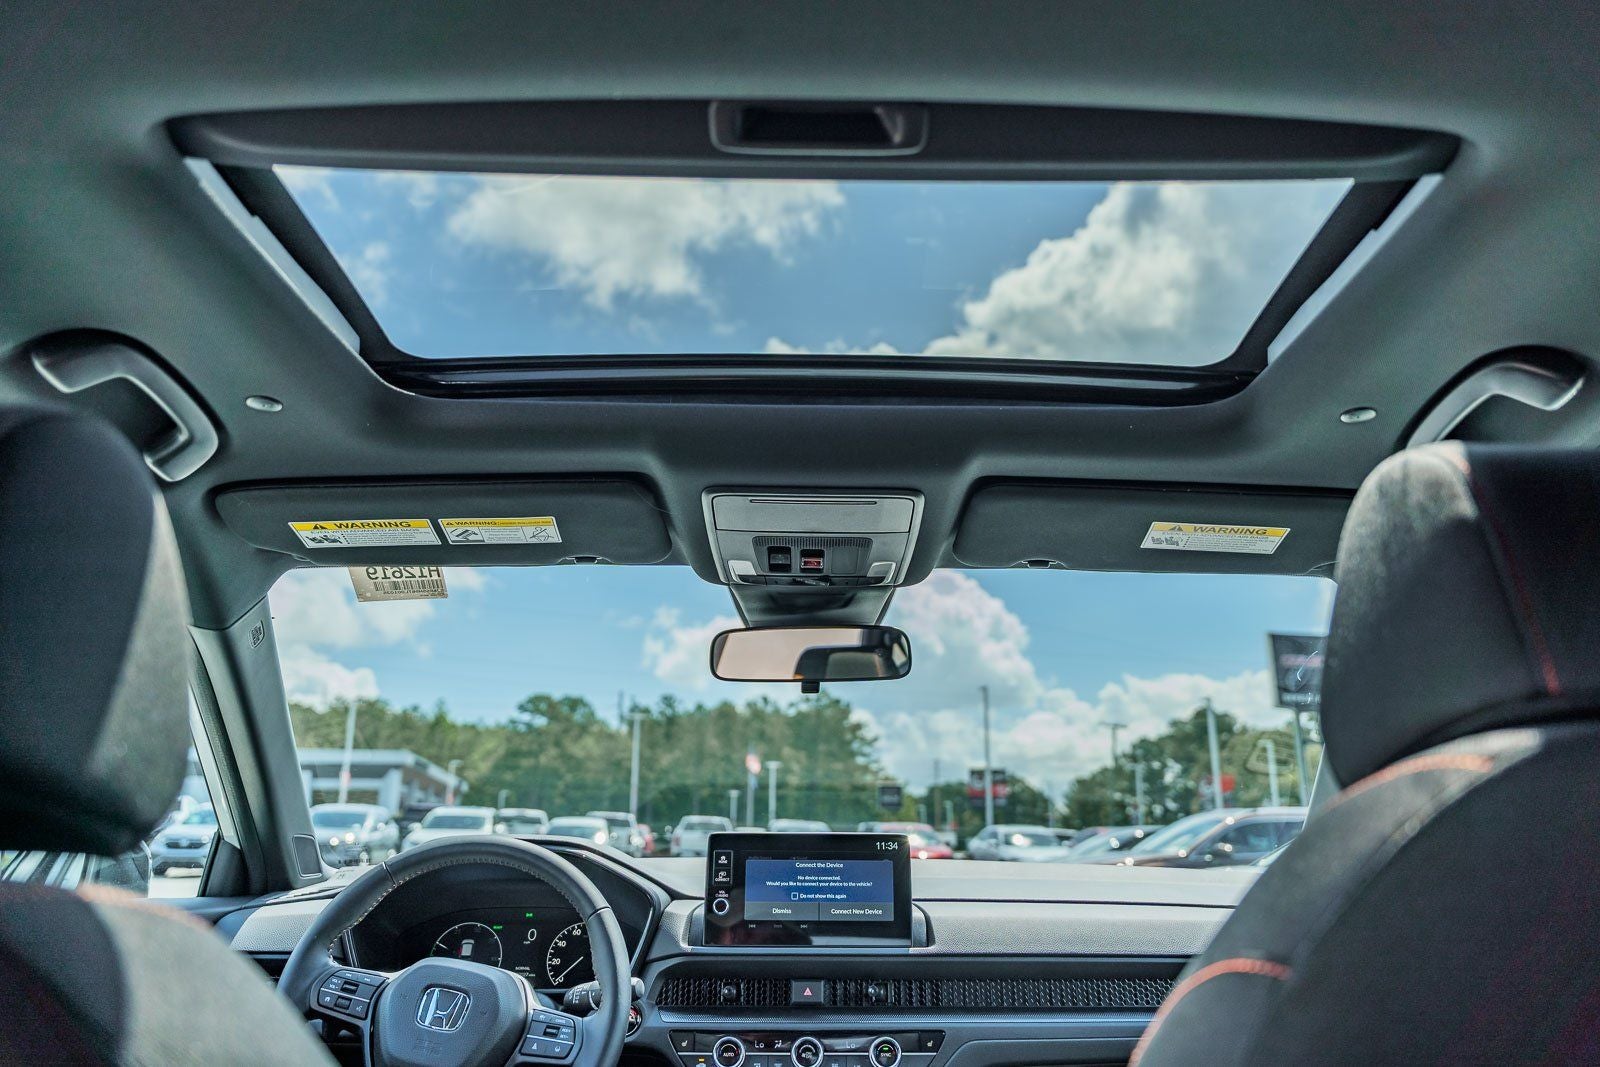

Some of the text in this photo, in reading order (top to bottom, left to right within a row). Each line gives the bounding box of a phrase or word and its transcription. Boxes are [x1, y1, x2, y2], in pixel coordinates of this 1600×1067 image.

[334, 521, 412, 529] WARNING
[1194, 526, 1268, 535] WARNING
[876, 842, 898, 850] 11:34
[528, 928, 537, 941] 0
